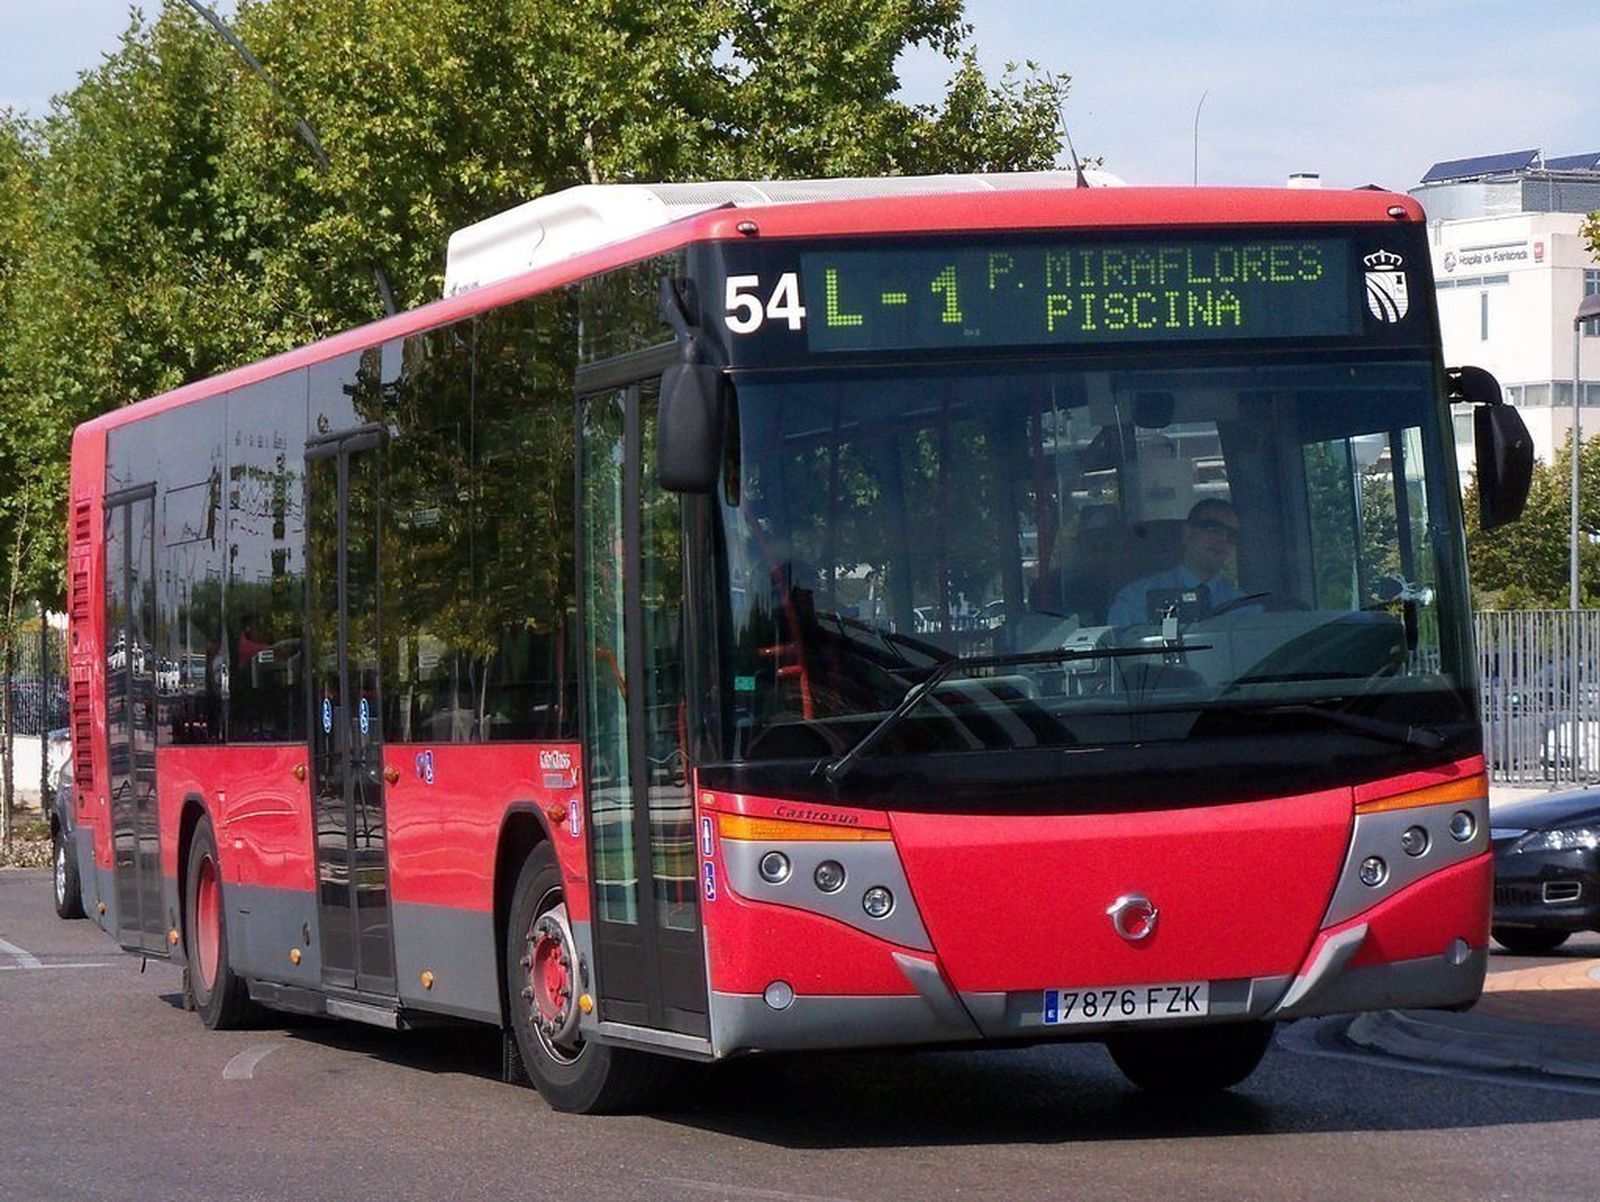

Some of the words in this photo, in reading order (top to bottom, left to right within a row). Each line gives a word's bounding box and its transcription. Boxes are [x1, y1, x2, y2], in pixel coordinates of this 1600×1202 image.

[988, 251, 1025, 290] P.
[1045, 245, 1323, 288] MIRAFLORES
[724, 272, 807, 334] 54
[1047, 289, 1242, 332] PISCINA
[775, 805, 860, 825] Castrosua
[1063, 989, 1136, 1019] 7876
[1147, 985, 1201, 1014] FZK
